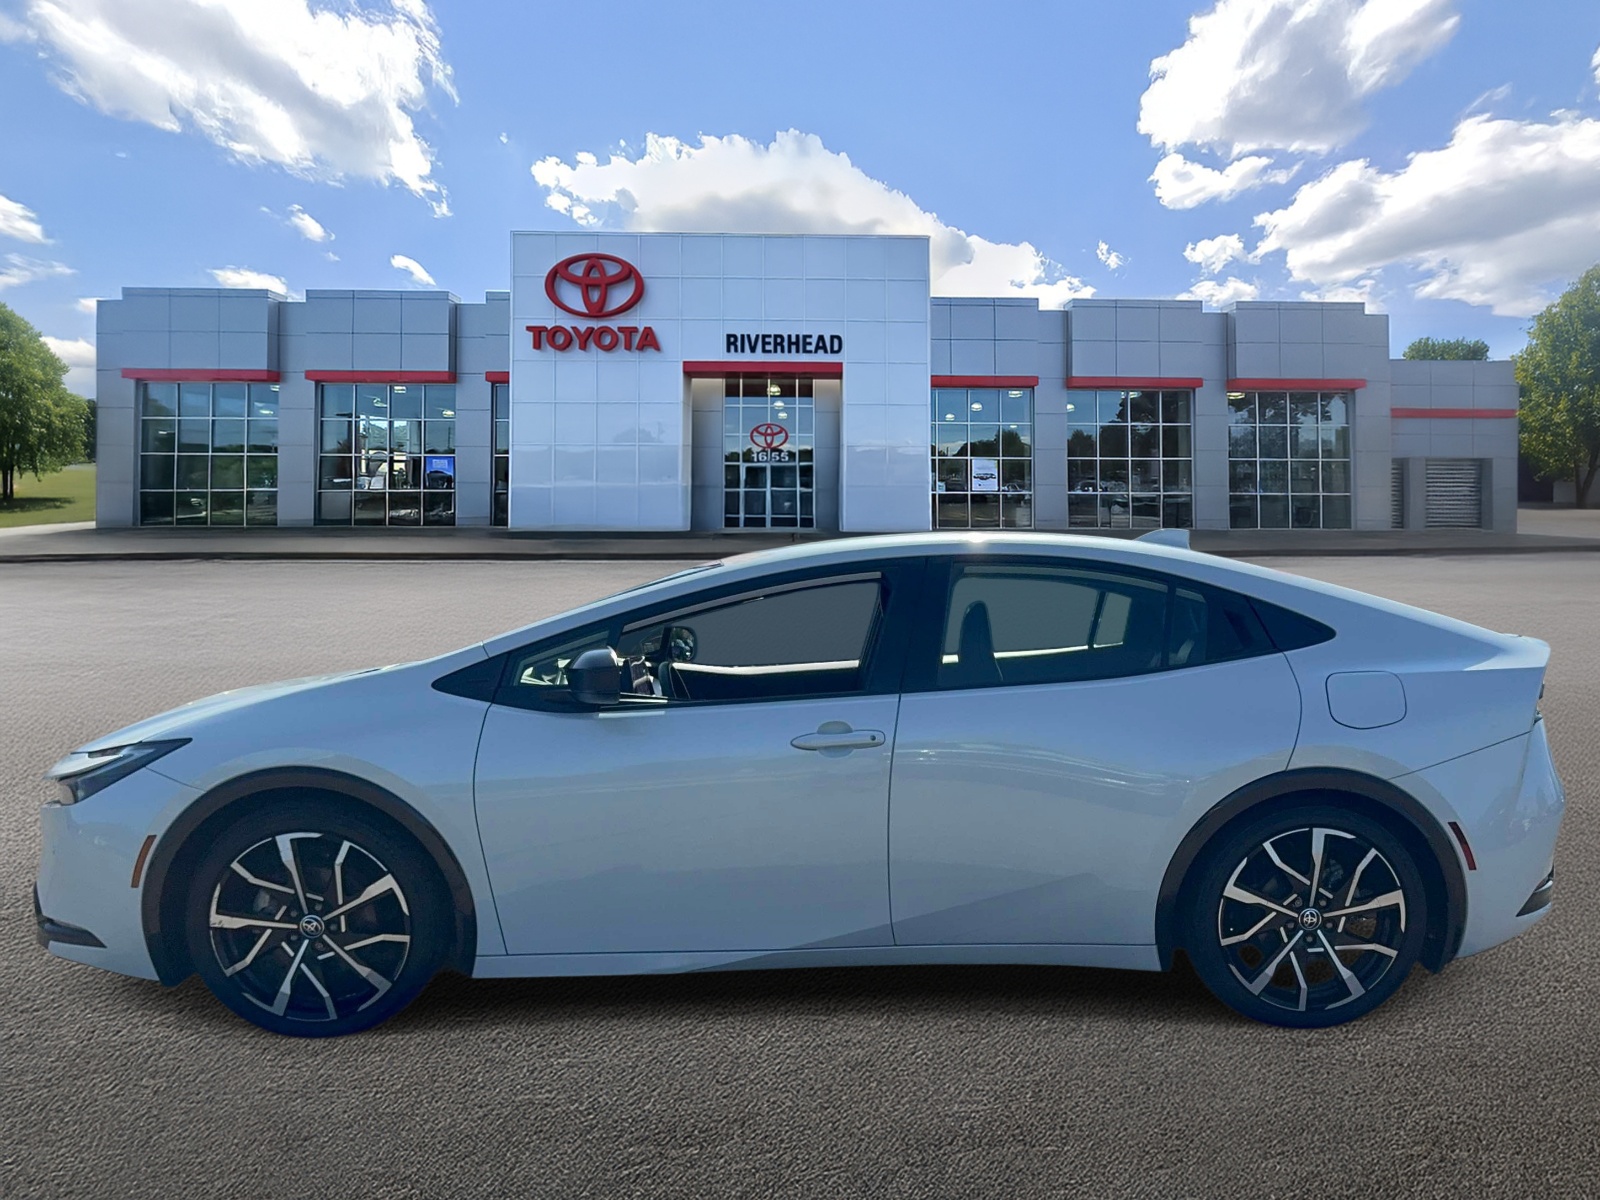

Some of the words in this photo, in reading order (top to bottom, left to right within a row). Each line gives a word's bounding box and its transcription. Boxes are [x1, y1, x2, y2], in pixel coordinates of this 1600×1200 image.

[525, 325, 661, 351] TOYOTA
[726, 333, 843, 354] RIVERHEAD
[751, 451, 789, 462] 1655
